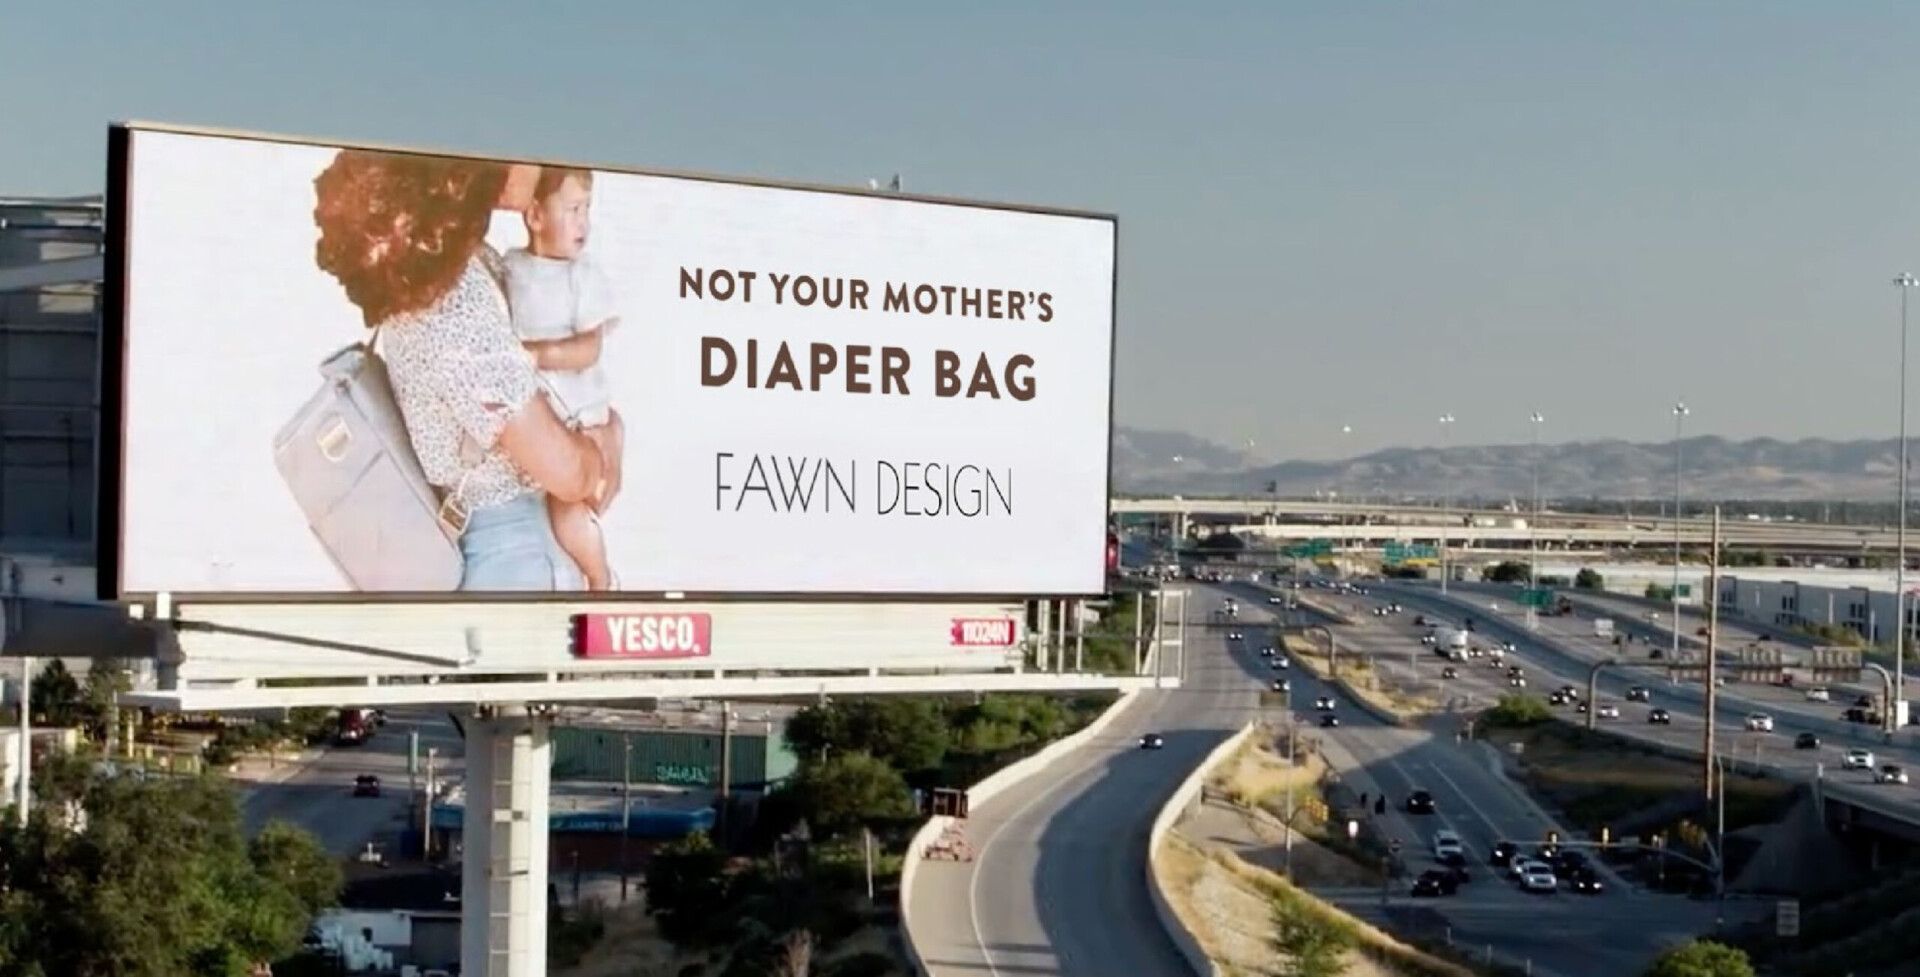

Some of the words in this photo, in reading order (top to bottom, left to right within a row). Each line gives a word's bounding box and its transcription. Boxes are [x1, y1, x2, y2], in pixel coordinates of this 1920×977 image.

[679, 265, 757, 303] NOT
[768, 272, 870, 311] YOUR
[882, 281, 1054, 323] MOTHER'S
[700, 335, 911, 396] DIAPER
[934, 350, 1037, 402] BAG
[716, 452, 856, 513] FAWN
[877, 460, 1012, 518] DESIGN
